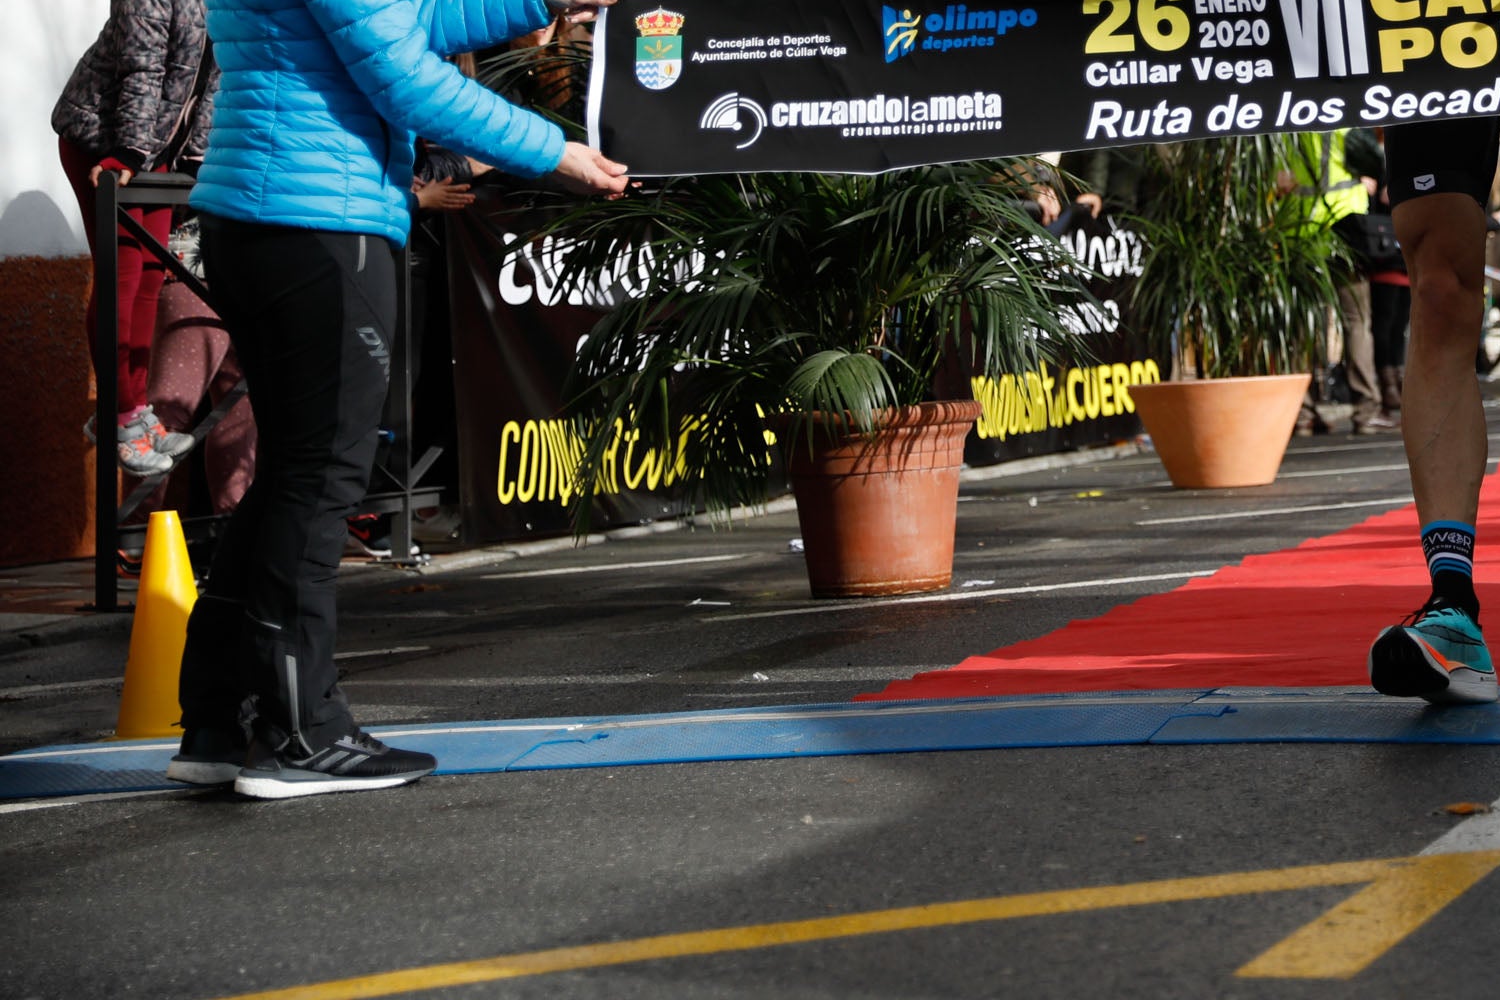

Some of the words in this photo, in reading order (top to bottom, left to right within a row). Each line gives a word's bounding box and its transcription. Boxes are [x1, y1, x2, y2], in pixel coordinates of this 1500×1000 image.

[924, 4, 1038, 35] olimpo
[708, 37, 765, 49] Concejalía
[767, 36, 780, 46] de
[783, 34, 831, 47] Deportes
[922, 35, 995, 52] deportes
[1198, 18, 1271, 48] 2020
[691, 50, 767, 63] Ayuntamiento
[769, 49, 783, 58] de
[785, 46, 817, 57] Cúllar
[820, 46, 847, 57] Vega
[1085, 60, 1182, 87] Cúllar
[1191, 56, 1274, 84] Vega
[1085, 99, 1193, 140] Ruta
[1206, 94, 1263, 131] de
[1275, 90, 1344, 128] los
[842, 121, 934, 137] cronometraje
[937, 119, 1002, 133] deportivo
